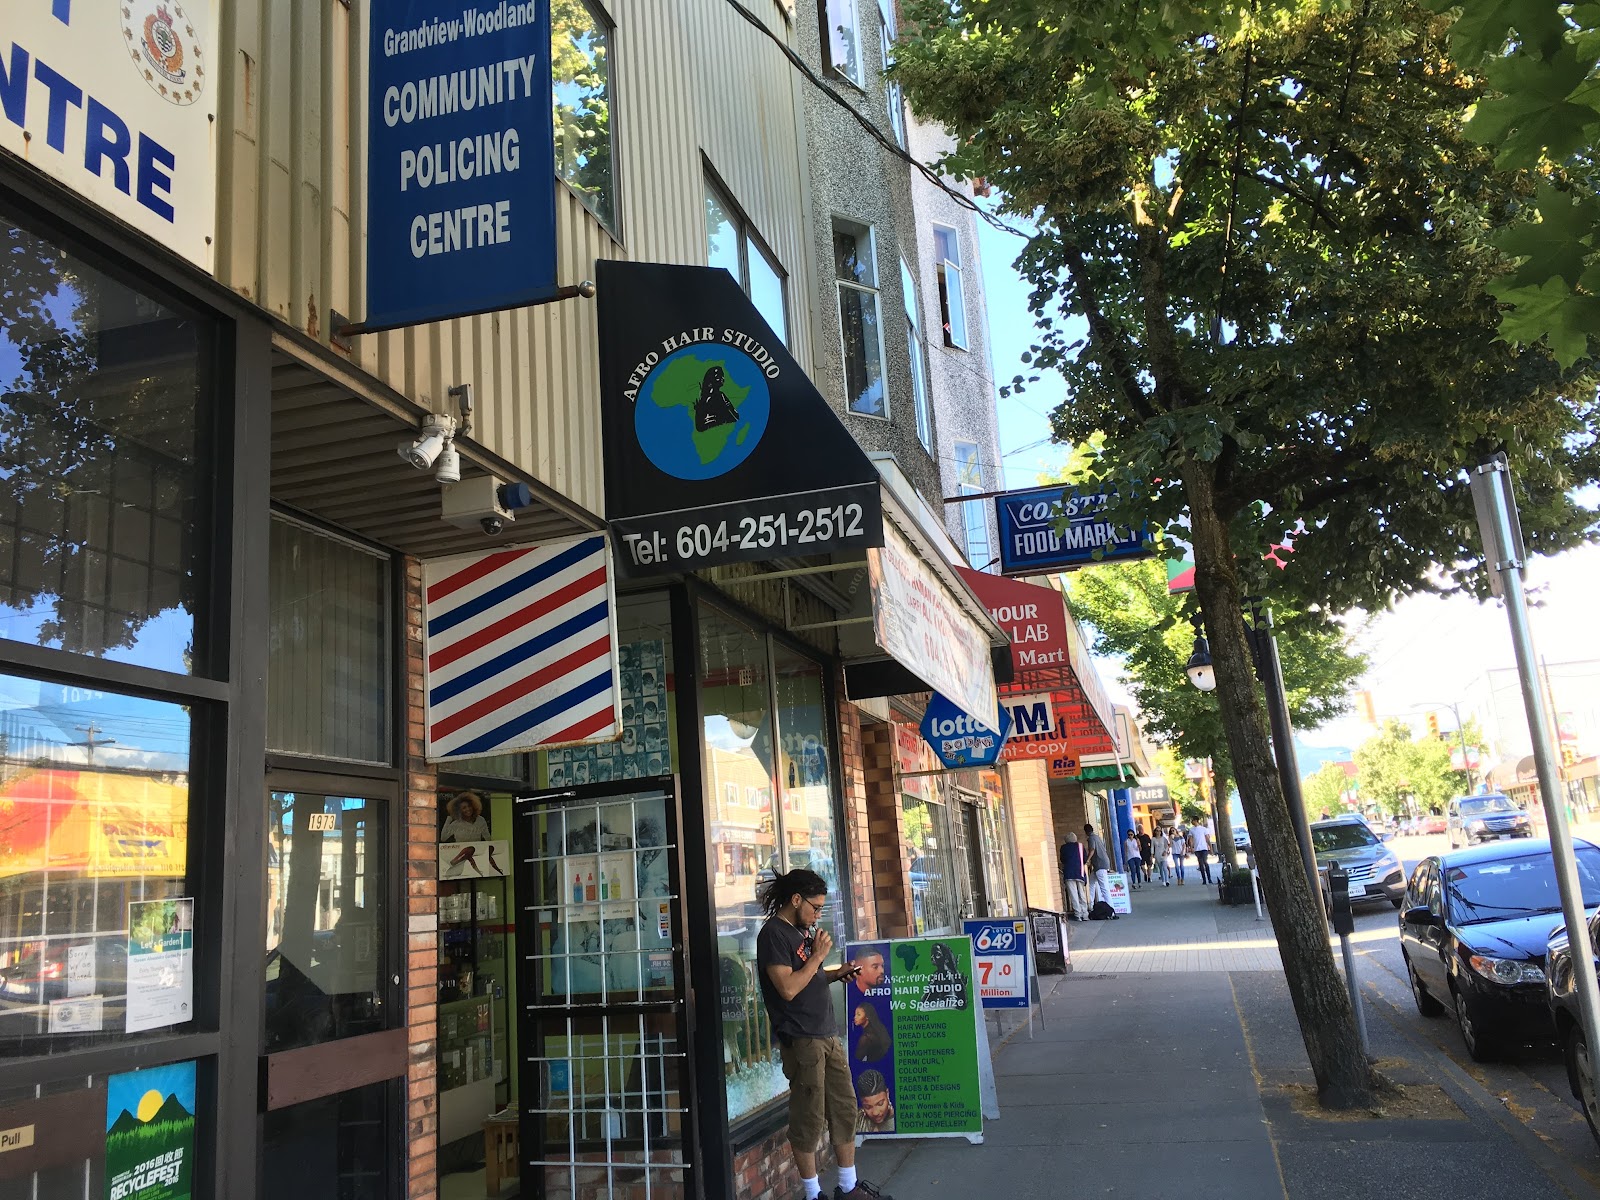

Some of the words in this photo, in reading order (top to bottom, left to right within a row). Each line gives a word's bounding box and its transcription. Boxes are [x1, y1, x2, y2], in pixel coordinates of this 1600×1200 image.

[384, 0, 535, 57] Grandview-Woodland
[384, 54, 536, 127] COMMUNITY
[400, 128, 520, 191] POLICING
[410, 200, 511, 258] CENTRE
[623, 351, 659, 402] AFRO
[661, 327, 715, 353] HAIR
[721, 328, 781, 379] STUDIO
[622, 531, 668, 566] Tel:
[676, 503, 864, 559] 604-251-2512
[1014, 529, 1060, 556] FOOD
[1013, 623, 1050, 644] LAB
[1018, 648, 1065, 667] Mart
[1053, 755, 1076, 770] Ria
[1135, 789, 1164, 800] FRIES
[311, 814, 335, 830] 1973
[864, 987, 891, 996] AFRO
[894, 985, 919, 995] HAIR
[923, 983, 962, 994] STUDIO
[890, 1000, 906, 1010] We
[910, 997, 964, 1012] Specialize
[898, 1048, 955, 1056] STRAIGHTENERS
[944, 1110, 977, 1118] PIERCING
[926, 1120, 967, 1128] JEWELLERY
[1, 1132, 21, 1147] Pull
[110, 1160, 183, 1200] RECYCLEFEST
[164, 1175, 179, 1187] 2016
